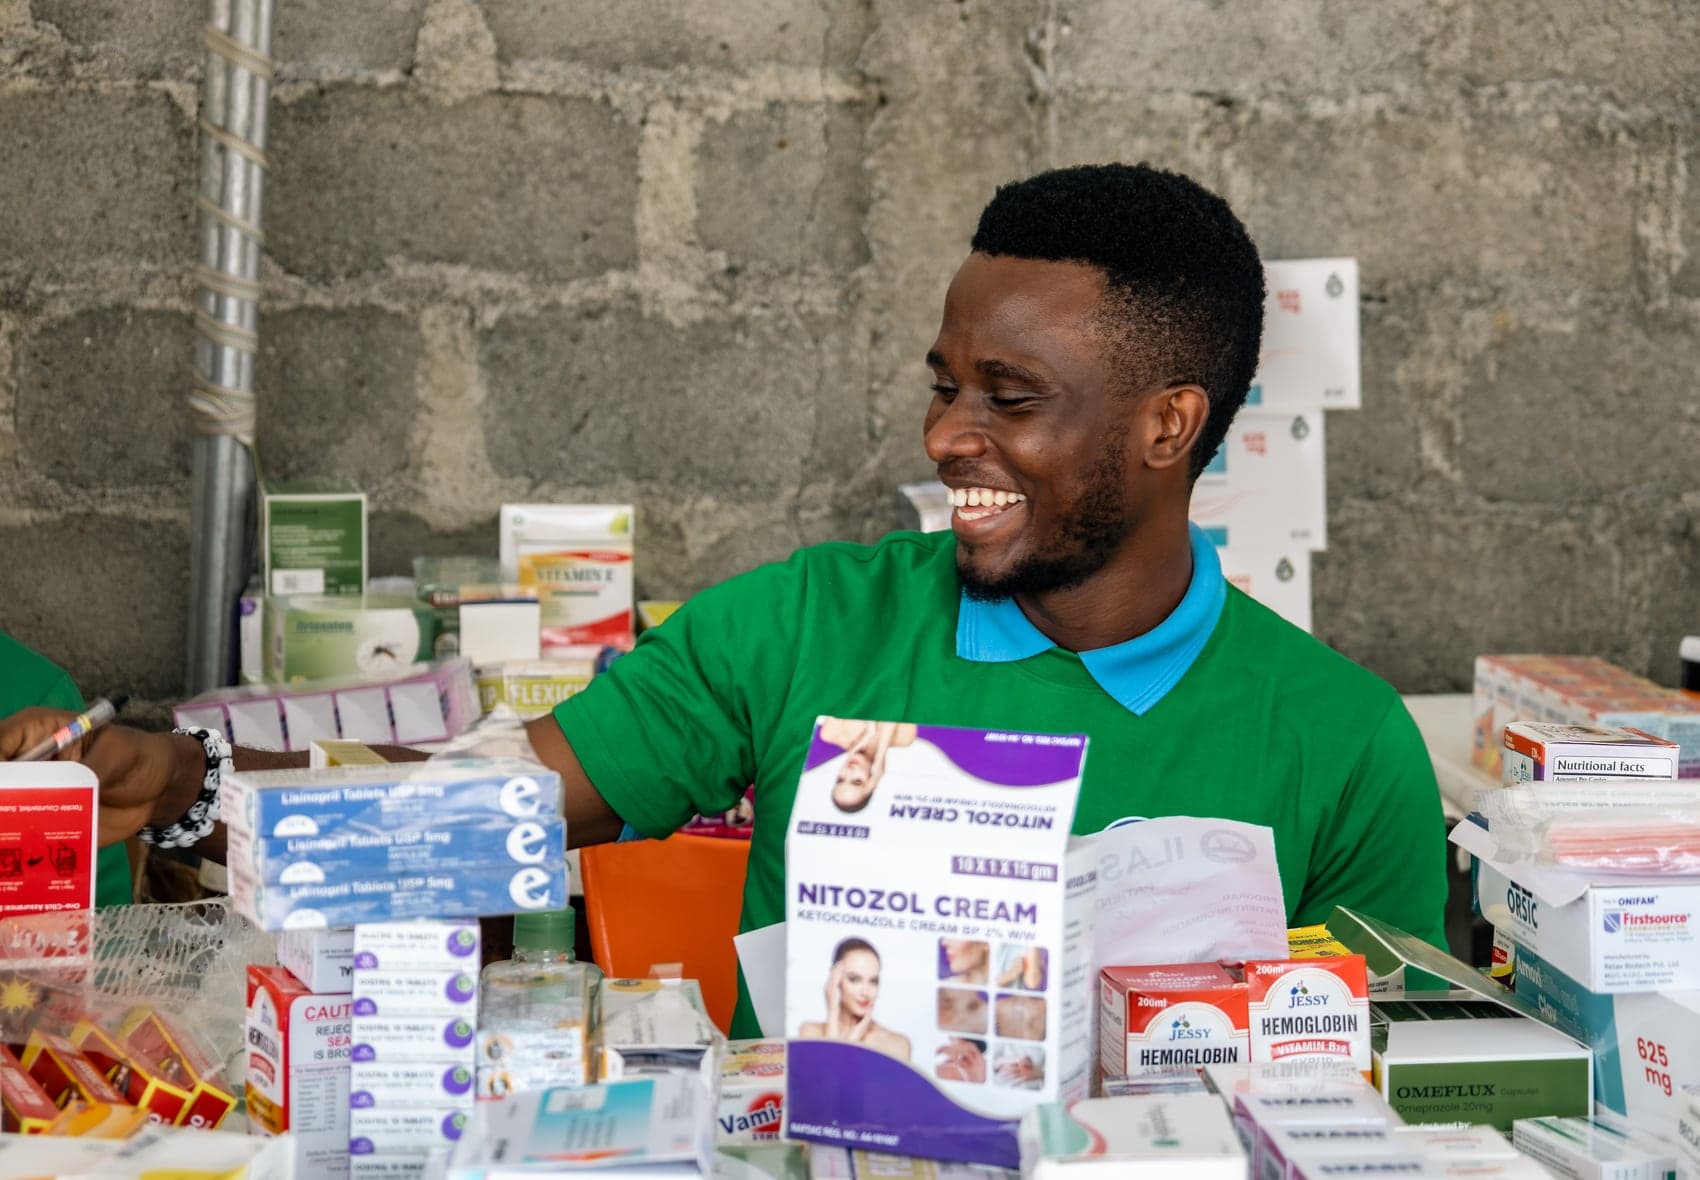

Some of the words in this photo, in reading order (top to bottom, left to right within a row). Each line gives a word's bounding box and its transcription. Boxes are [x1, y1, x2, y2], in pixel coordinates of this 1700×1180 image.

[510, 683, 588, 705] FLEXIC
[1557, 759, 1616, 772] Nutritional
[1619, 760, 1645, 772] facts
[889, 804, 958, 823] CREAM
[966, 809, 1053, 830] NITOZOL
[798, 882, 925, 914] NITOZOL
[934, 896, 1038, 924] CREAM
[1618, 895, 1655, 906] ONIFAM
[797, 909, 906, 930] KETOCONAZOLE
[909, 919, 958, 934] CREAM
[1623, 911, 1687, 925] Firstsource
[1255, 964, 1284, 975] 200ml
[1138, 997, 1167, 1008] 200ml
[1288, 995, 1329, 1009] JESSY
[304, 1003, 351, 1021] CAUT
[316, 1025, 351, 1037] REJEC
[1261, 1014, 1358, 1036] HEMOGLOBIN
[1169, 1028, 1211, 1041] JESSY
[327, 1037, 351, 1047] SEA
[1277, 1041, 1323, 1055] VITAMIN
[327, 1049, 351, 1061] BRO
[1140, 1046, 1238, 1066] HEMOGLOBIN
[1637, 1036, 1669, 1067] 625
[1645, 1066, 1673, 1097] mg
[1396, 1084, 1496, 1099] OMEFLUX
[1396, 1103, 1460, 1115] Omeprazole
[1463, 1102, 1493, 1113] 20mg
[718, 1102, 783, 1135] Vami-
